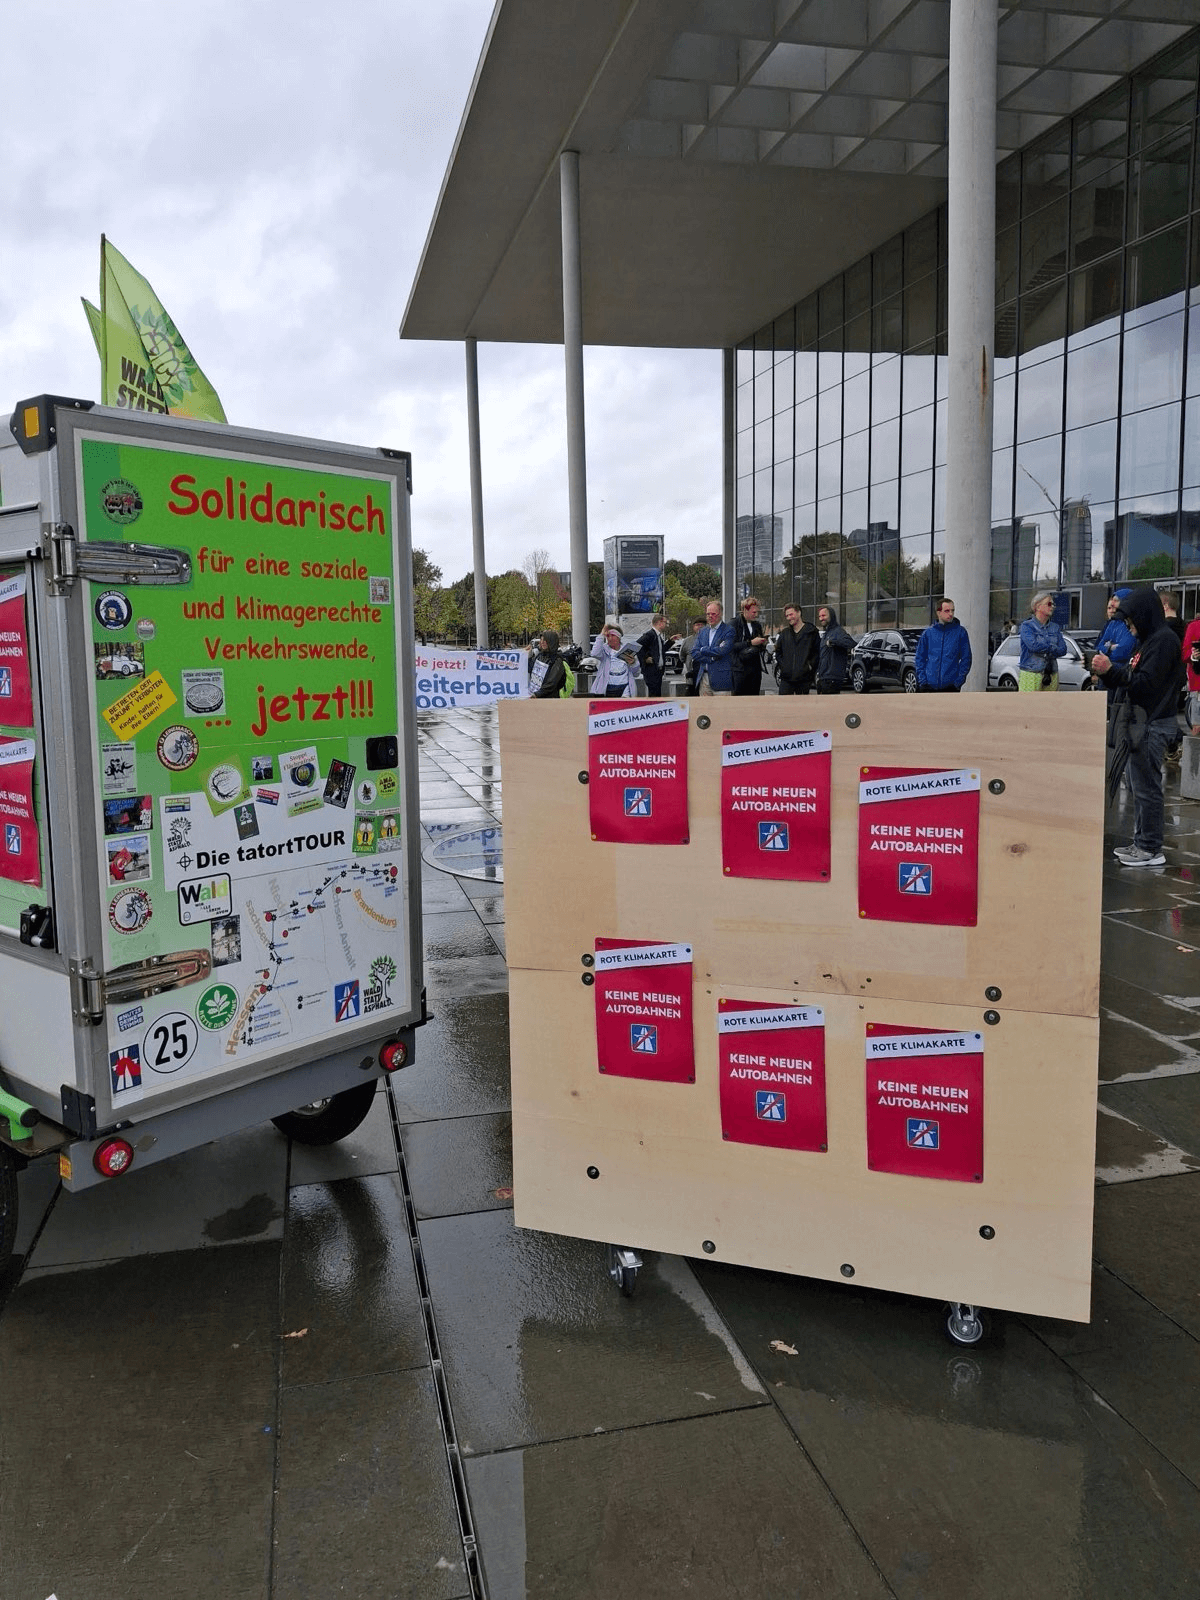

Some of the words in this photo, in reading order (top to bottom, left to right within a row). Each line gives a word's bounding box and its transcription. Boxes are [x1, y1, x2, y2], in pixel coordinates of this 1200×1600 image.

[168, 474, 385, 535] Solidarisch
[197, 547, 234, 573] für
[245, 553, 290, 576] eine
[301, 558, 368, 580] soziale
[183, 596, 224, 620] und
[236, 596, 382, 628] klimagerechte
[205, 636, 375, 663] Verkehrswende,
[432, 658, 466, 671] jetzt!
[416, 673, 520, 695] eiterbau
[108, 689, 139, 715] BETRETEN
[140, 679, 152, 692] DER
[109, 701, 135, 724] ZUKUNFT
[134, 679, 164, 703] VERBOTEN
[251, 679, 374, 737] jetzt!!!
[594, 718, 616, 729] ROTE
[618, 708, 674, 724] KLIMAKARTE
[727, 749, 751, 760] ROTE
[754, 739, 814, 755] KLIMAKARTE
[599, 754, 633, 764] KEINE
[637, 754, 676, 765] NEUEN
[599, 768, 676, 778] AUTOBAHNEN
[732, 786, 768, 797] KEINE
[772, 787, 816, 798] NEUEN
[866, 786, 892, 796] ROTE
[895, 777, 961, 793] KLIMAKARTE
[732, 801, 816, 813] AUTOBAHNEN
[870, 824, 911, 837] KEINE
[915, 827, 963, 838] NEUEN
[196, 850, 230, 869] Die
[237, 830, 345, 862] tatortTOUR
[870, 840, 963, 854] AUTOBAHNEN
[181, 879, 228, 904] Wald
[353, 889, 397, 929] Brandenburg
[600, 954, 622, 964] ROTE
[624, 950, 677, 961] KLIMAKARTE
[364, 985, 381, 997] WALD
[364, 994, 382, 1006] STATT
[605, 990, 639, 1001] KEINE
[642, 992, 681, 1004] NEUEN
[606, 1004, 681, 1018] AUTOBAHNEN
[724, 1017, 747, 1026] ROTE
[749, 1012, 808, 1024] KLIMAKARTE
[225, 988, 260, 1056] Hessen
[153, 1019, 188, 1066] 25
[872, 1042, 898, 1052] ROTE
[900, 1038, 965, 1050] KLIMAKARTE
[729, 1053, 766, 1066] KEINE
[769, 1057, 812, 1070] NEUEN
[730, 1068, 812, 1085] AUTOBAHNEN
[877, 1080, 918, 1094] KEINE
[922, 1085, 969, 1099] NEUEN
[878, 1096, 969, 1114] AUTOBAHNEN
